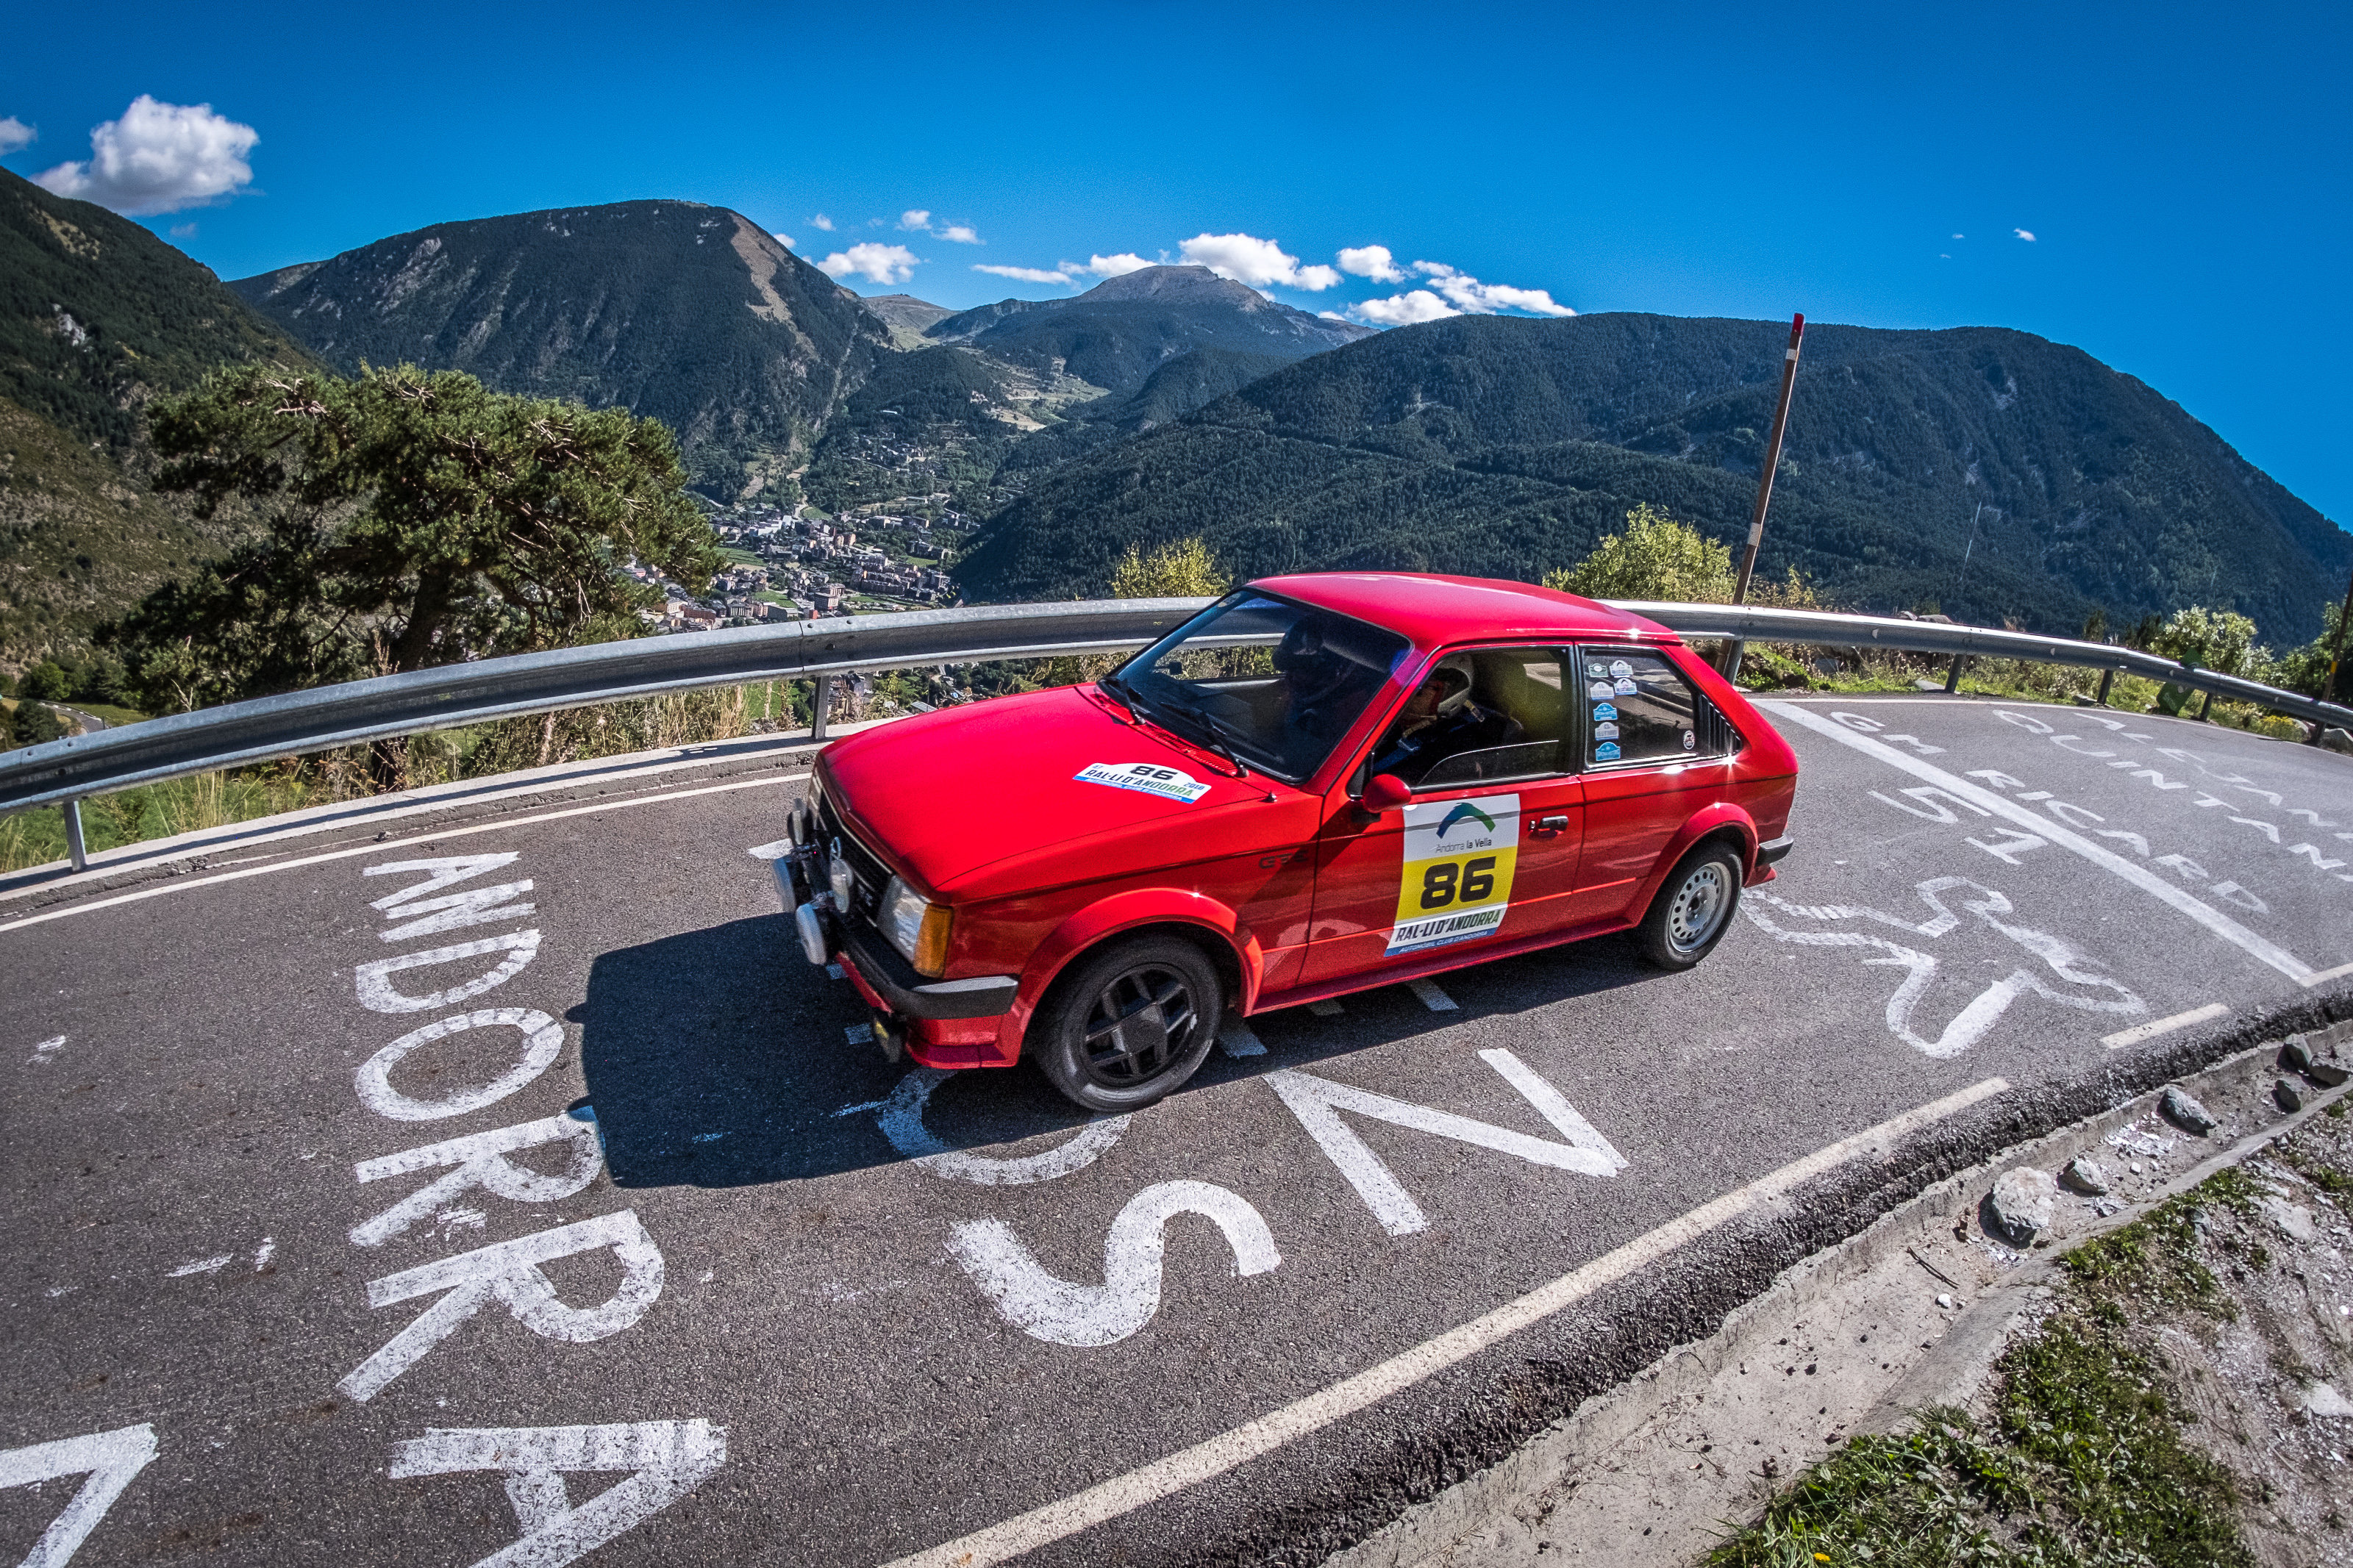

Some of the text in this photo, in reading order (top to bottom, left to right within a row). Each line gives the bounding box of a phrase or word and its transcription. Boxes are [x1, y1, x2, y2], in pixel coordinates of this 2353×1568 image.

[1129, 765, 1178, 781] 86
[1183, 781, 1205, 791] 2018
[1829, 711, 2270, 914] GM RICARD
[1866, 786, 2049, 865] 51
[1435, 837, 1492, 853] Andorra la Vella
[1420, 856, 1497, 910] 86
[336, 851, 728, 1568] ANDORRA
